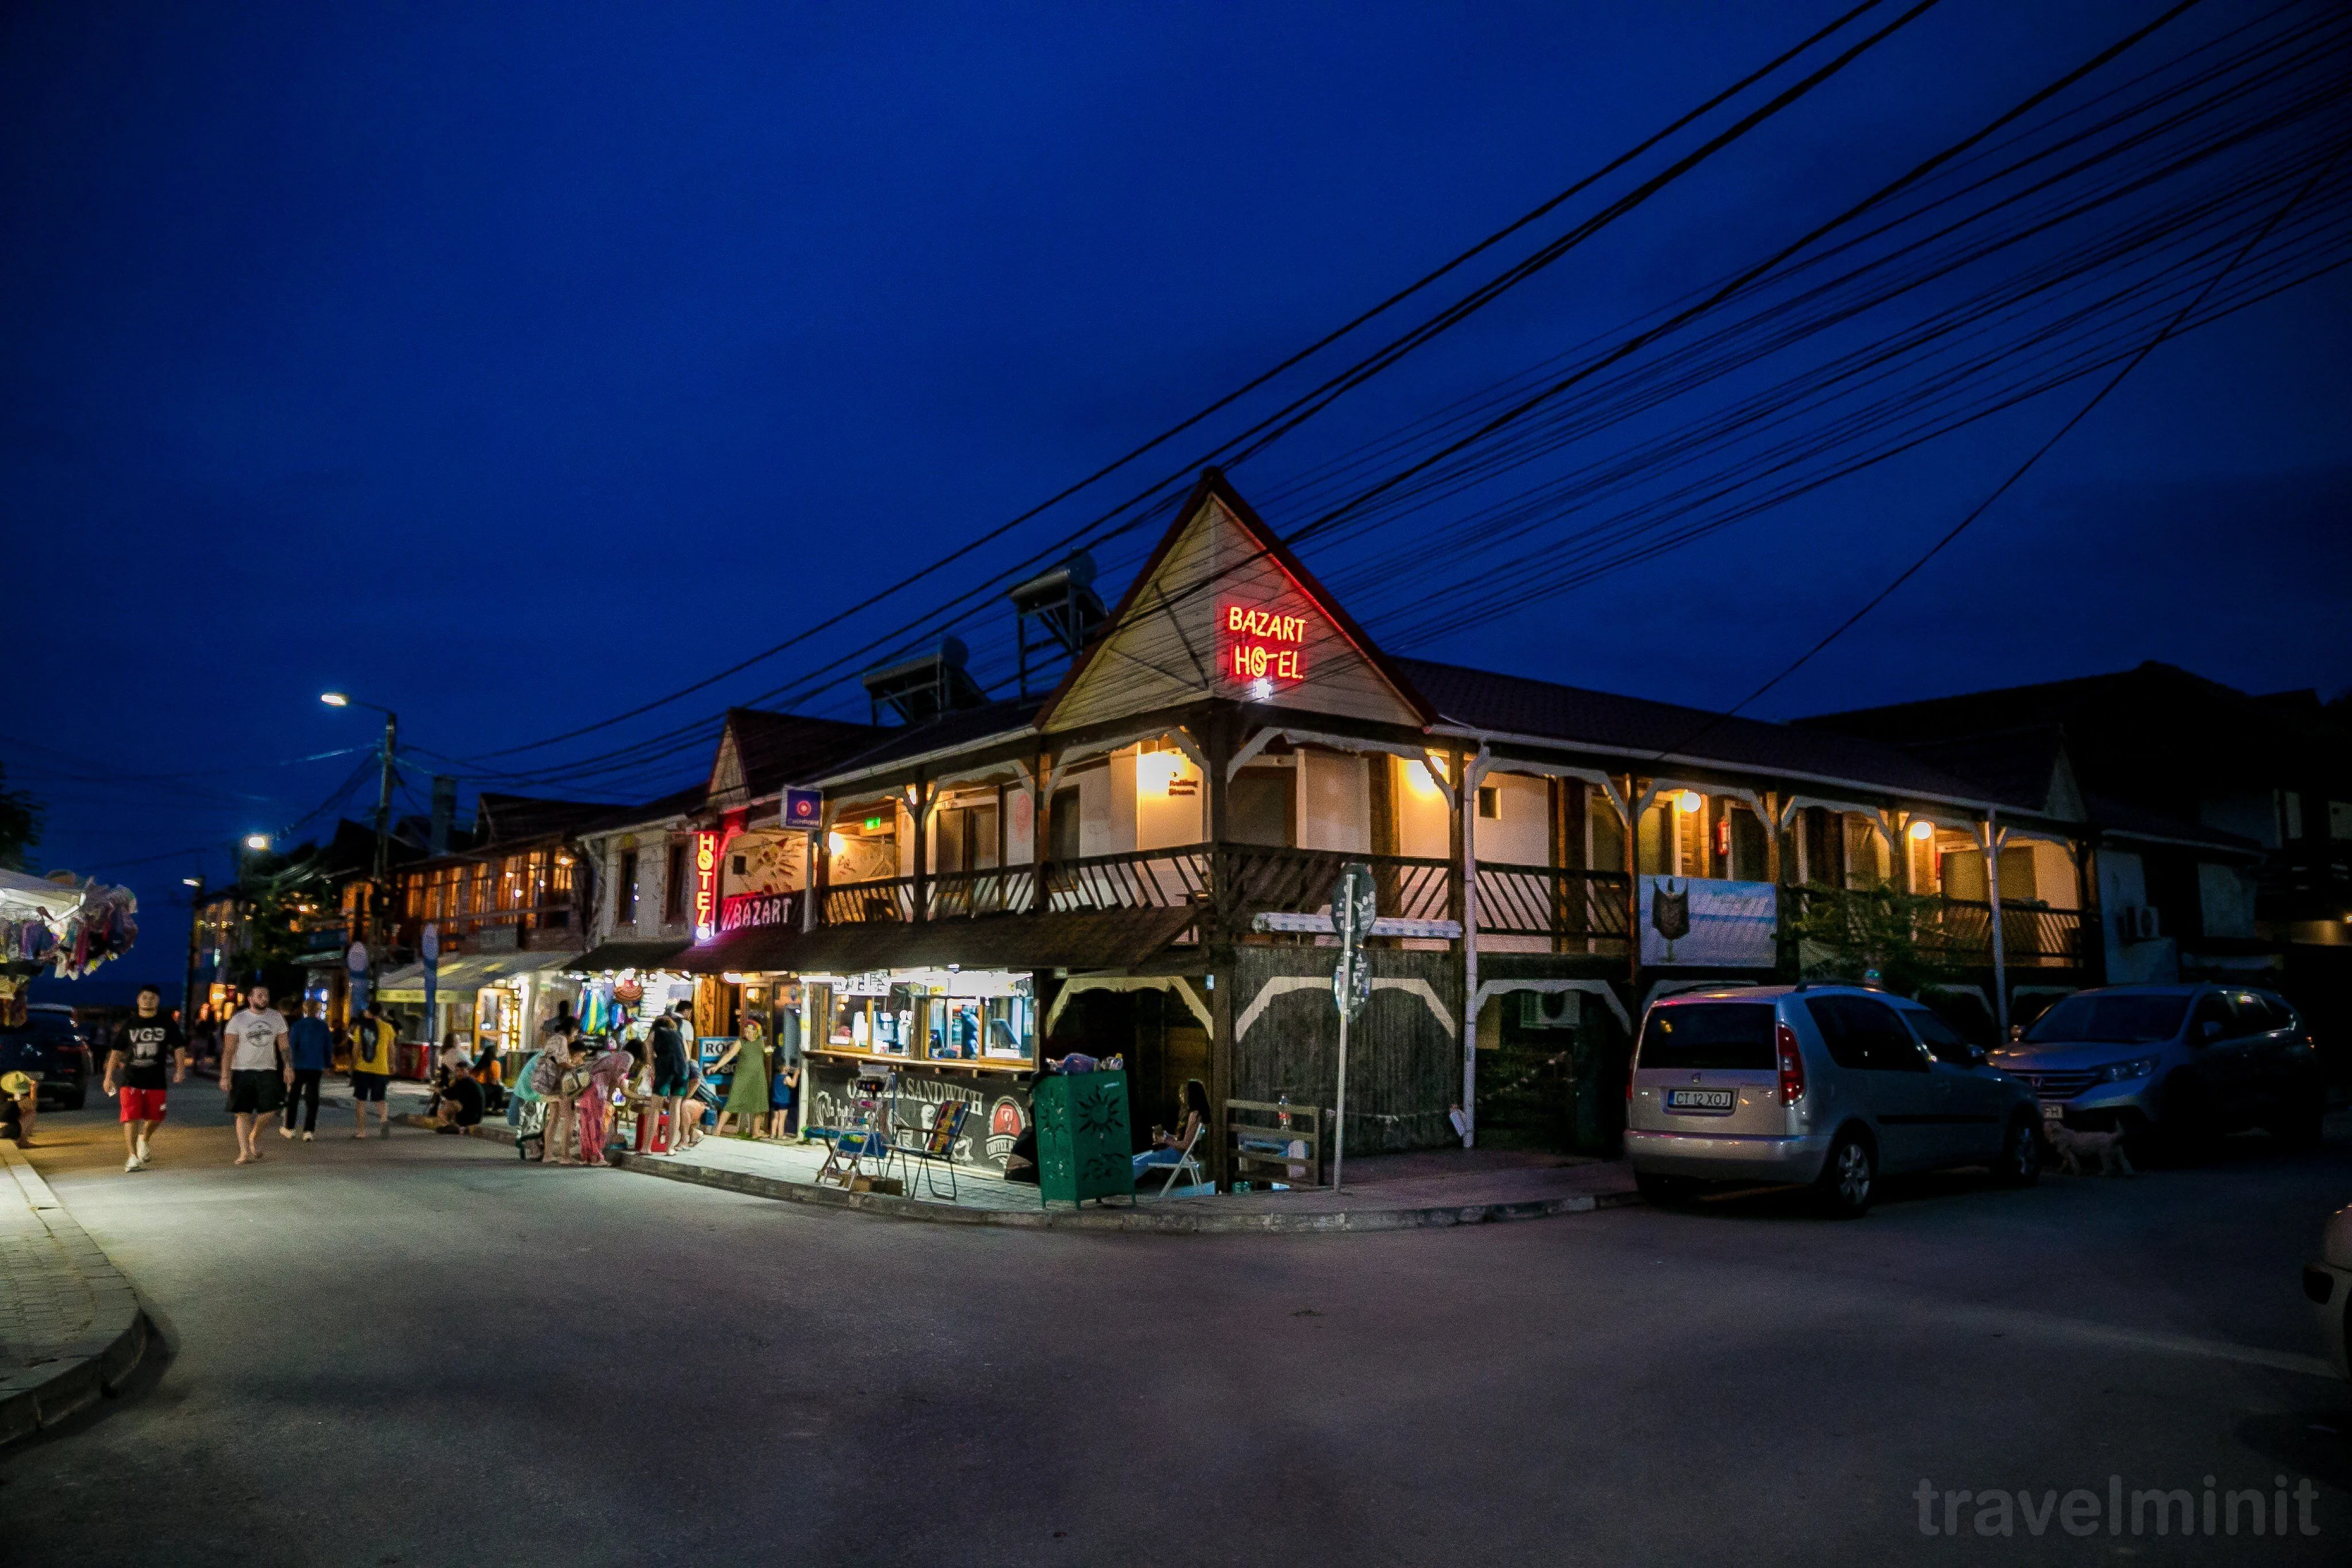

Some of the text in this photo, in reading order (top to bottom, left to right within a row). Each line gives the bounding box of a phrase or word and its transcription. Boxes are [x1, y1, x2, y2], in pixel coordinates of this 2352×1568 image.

[1229, 606, 1306, 642] BAZART
[1235, 645, 1303, 679] HOTEL
[697, 833, 714, 928] HOTEL
[733, 897, 792, 926] BAZART
[905, 1077, 983, 1116] SANDWICH
[1677, 1093, 1690, 1104] CT
[1693, 1093, 1704, 1105] 12
